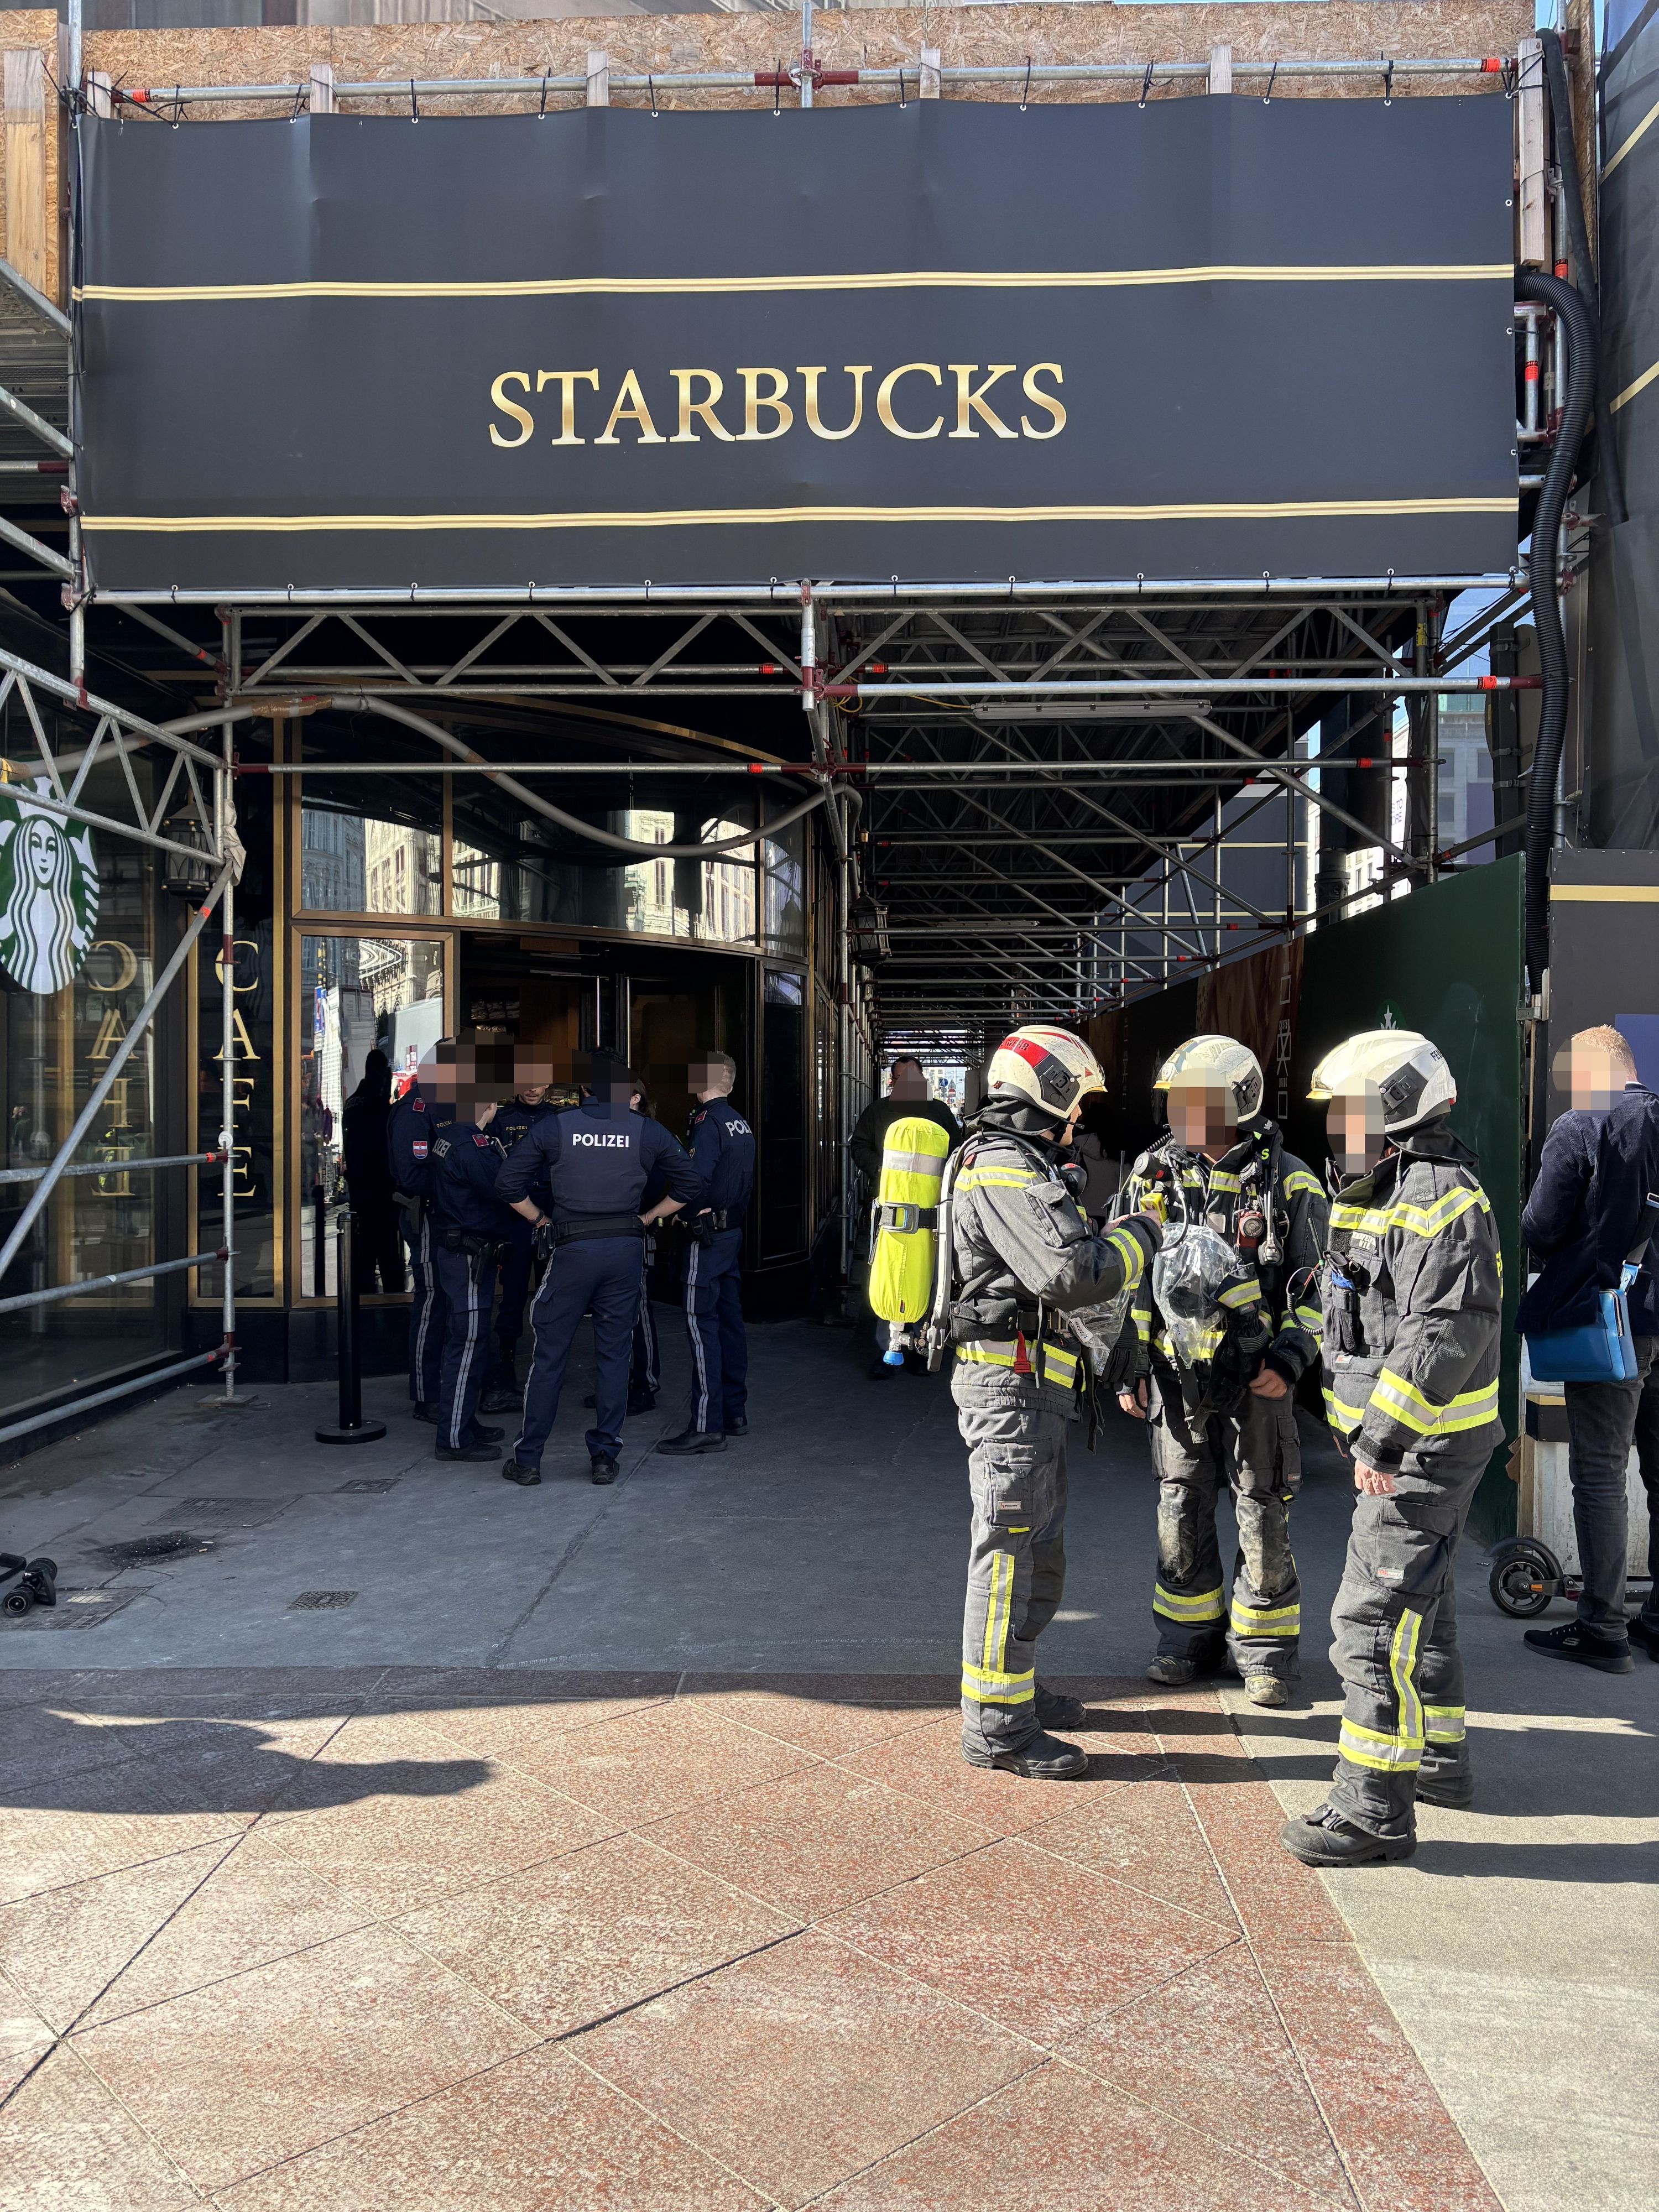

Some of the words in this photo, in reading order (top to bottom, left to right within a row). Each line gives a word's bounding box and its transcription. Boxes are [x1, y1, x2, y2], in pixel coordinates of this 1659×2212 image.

[489, 362, 1067, 448] STARBUCKS
[213, 940, 261, 1197] CAFE
[572, 1134, 629, 1147] POLIZEI
[1261, 1148, 1269, 1160] S
